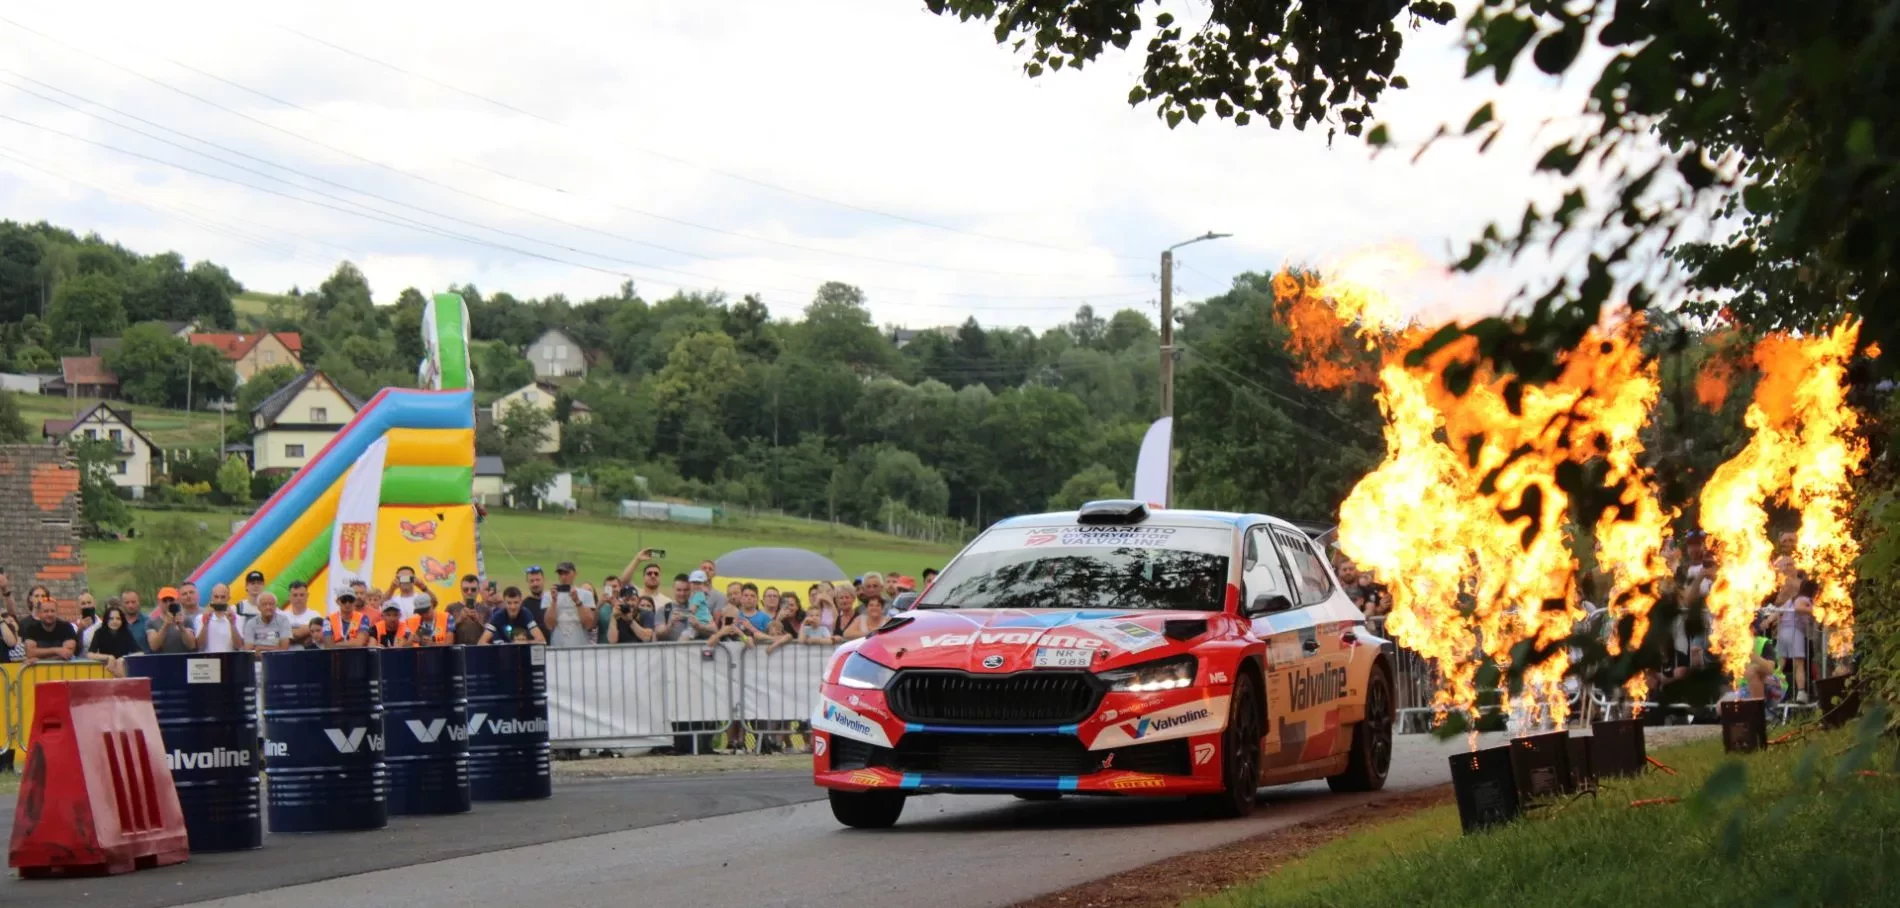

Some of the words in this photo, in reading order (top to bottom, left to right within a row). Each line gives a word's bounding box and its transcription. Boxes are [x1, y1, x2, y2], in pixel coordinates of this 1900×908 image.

[1061, 538, 1168, 546] VALVOLINE
[920, 630, 1104, 651] Valvoline
[1056, 649, 1074, 657] NR
[1288, 660, 1348, 713] Valvoline
[834, 711, 871, 736] Valvoline
[1152, 708, 1208, 731] Valvoline
[164, 747, 250, 770] alvoline
